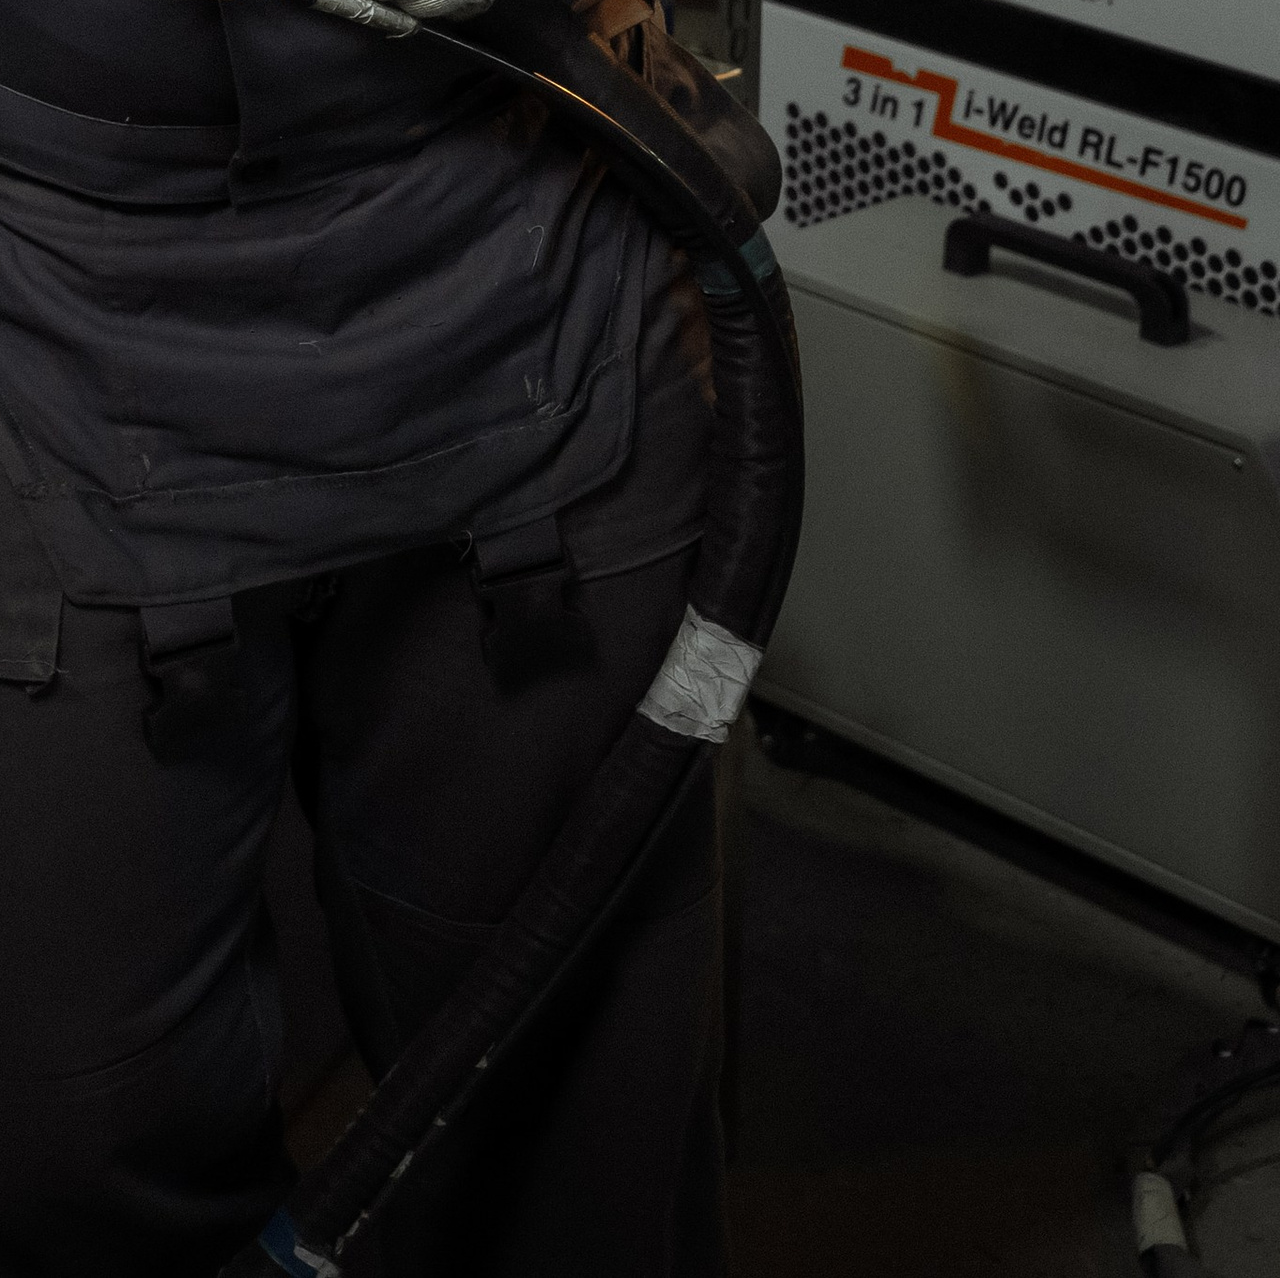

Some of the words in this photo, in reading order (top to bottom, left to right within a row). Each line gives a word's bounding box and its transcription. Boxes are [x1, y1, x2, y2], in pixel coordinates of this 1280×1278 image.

[842, 76, 862, 106] 3
[870, 84, 898, 120] in
[913, 98, 924, 127] 1
[964, 88, 1069, 149] i-Weld
[1079, 127, 1247, 207] RL-F1500
